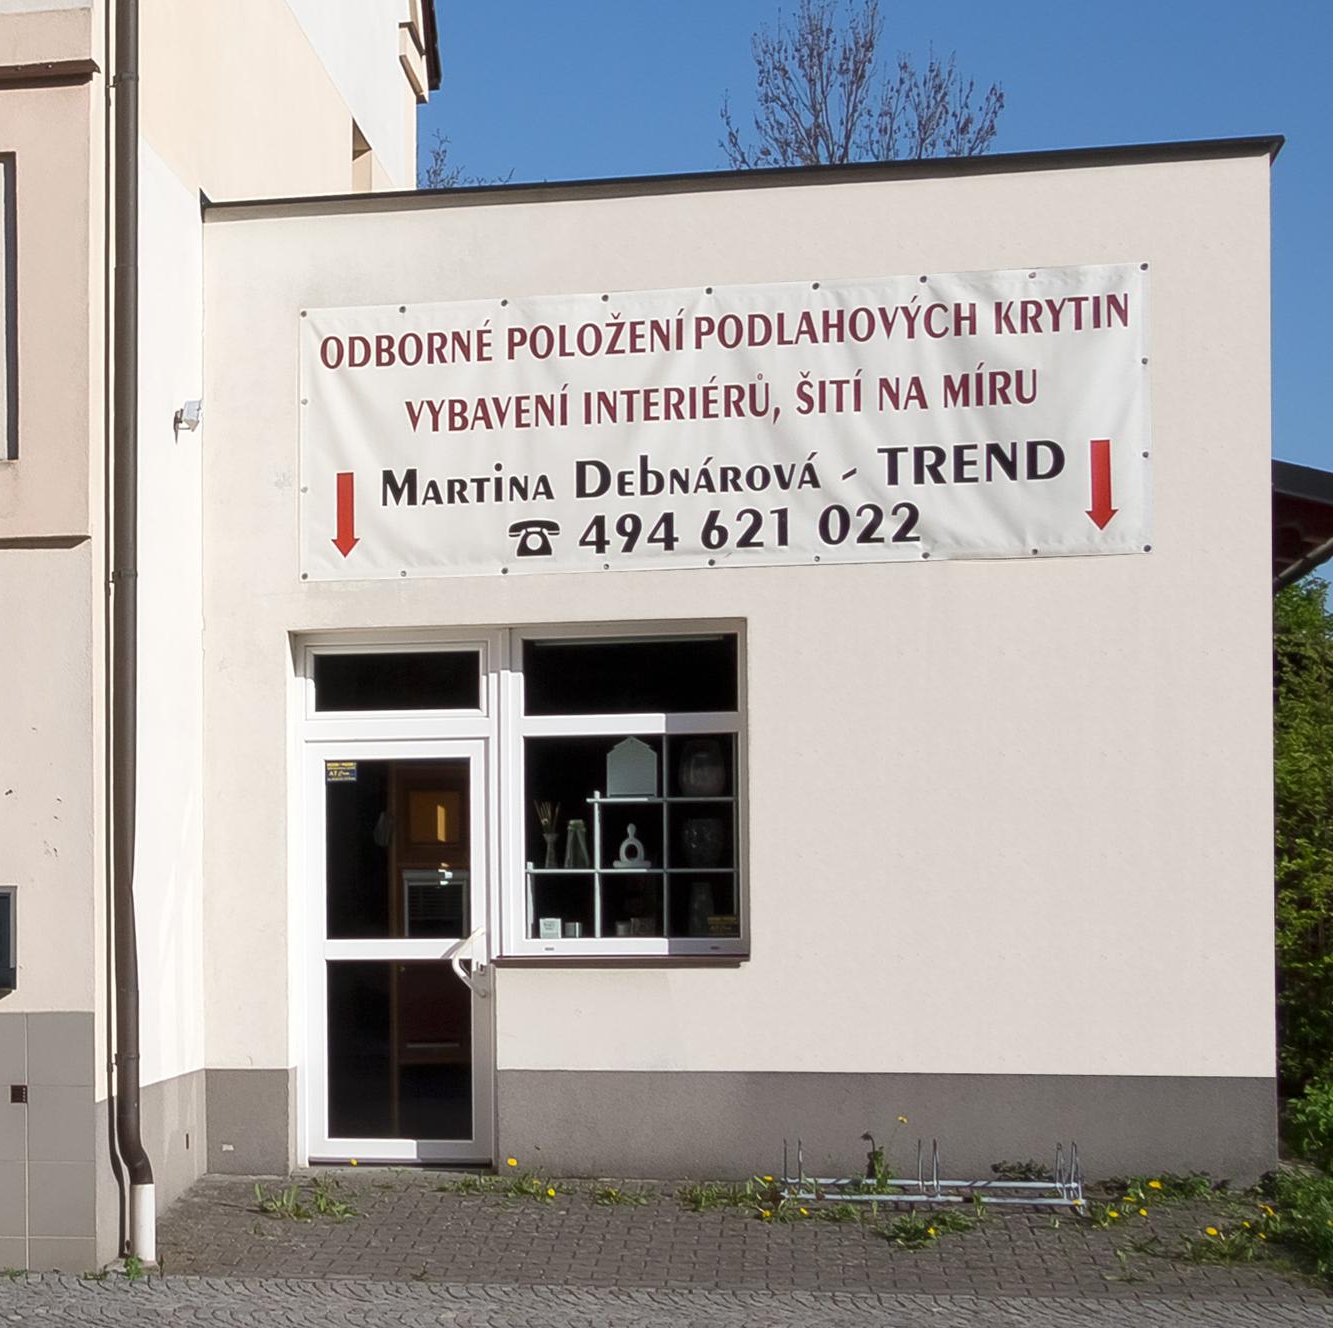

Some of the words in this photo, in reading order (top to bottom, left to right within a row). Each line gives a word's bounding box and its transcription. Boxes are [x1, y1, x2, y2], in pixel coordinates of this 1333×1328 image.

[320, 320, 493, 370] ODBORNÉ
[507, 308, 685, 360] POLOŽENÍ
[694, 295, 977, 350] PODLAHOVÝCH
[994, 293, 1128, 335] KRYTIN
[404, 384, 569, 432] VYBAVENÍ
[584, 373, 781, 425] INTERIÉRŮ,
[796, 369, 862, 415] ŠITÍ
[878, 376, 929, 412] NA
[943, 362, 1037, 410] MÍRU
[877, 440, 1066, 486] TREND
[578, 509, 679, 554] 494
[700, 507, 789, 550] 621
[818, 502, 921, 546] 022
